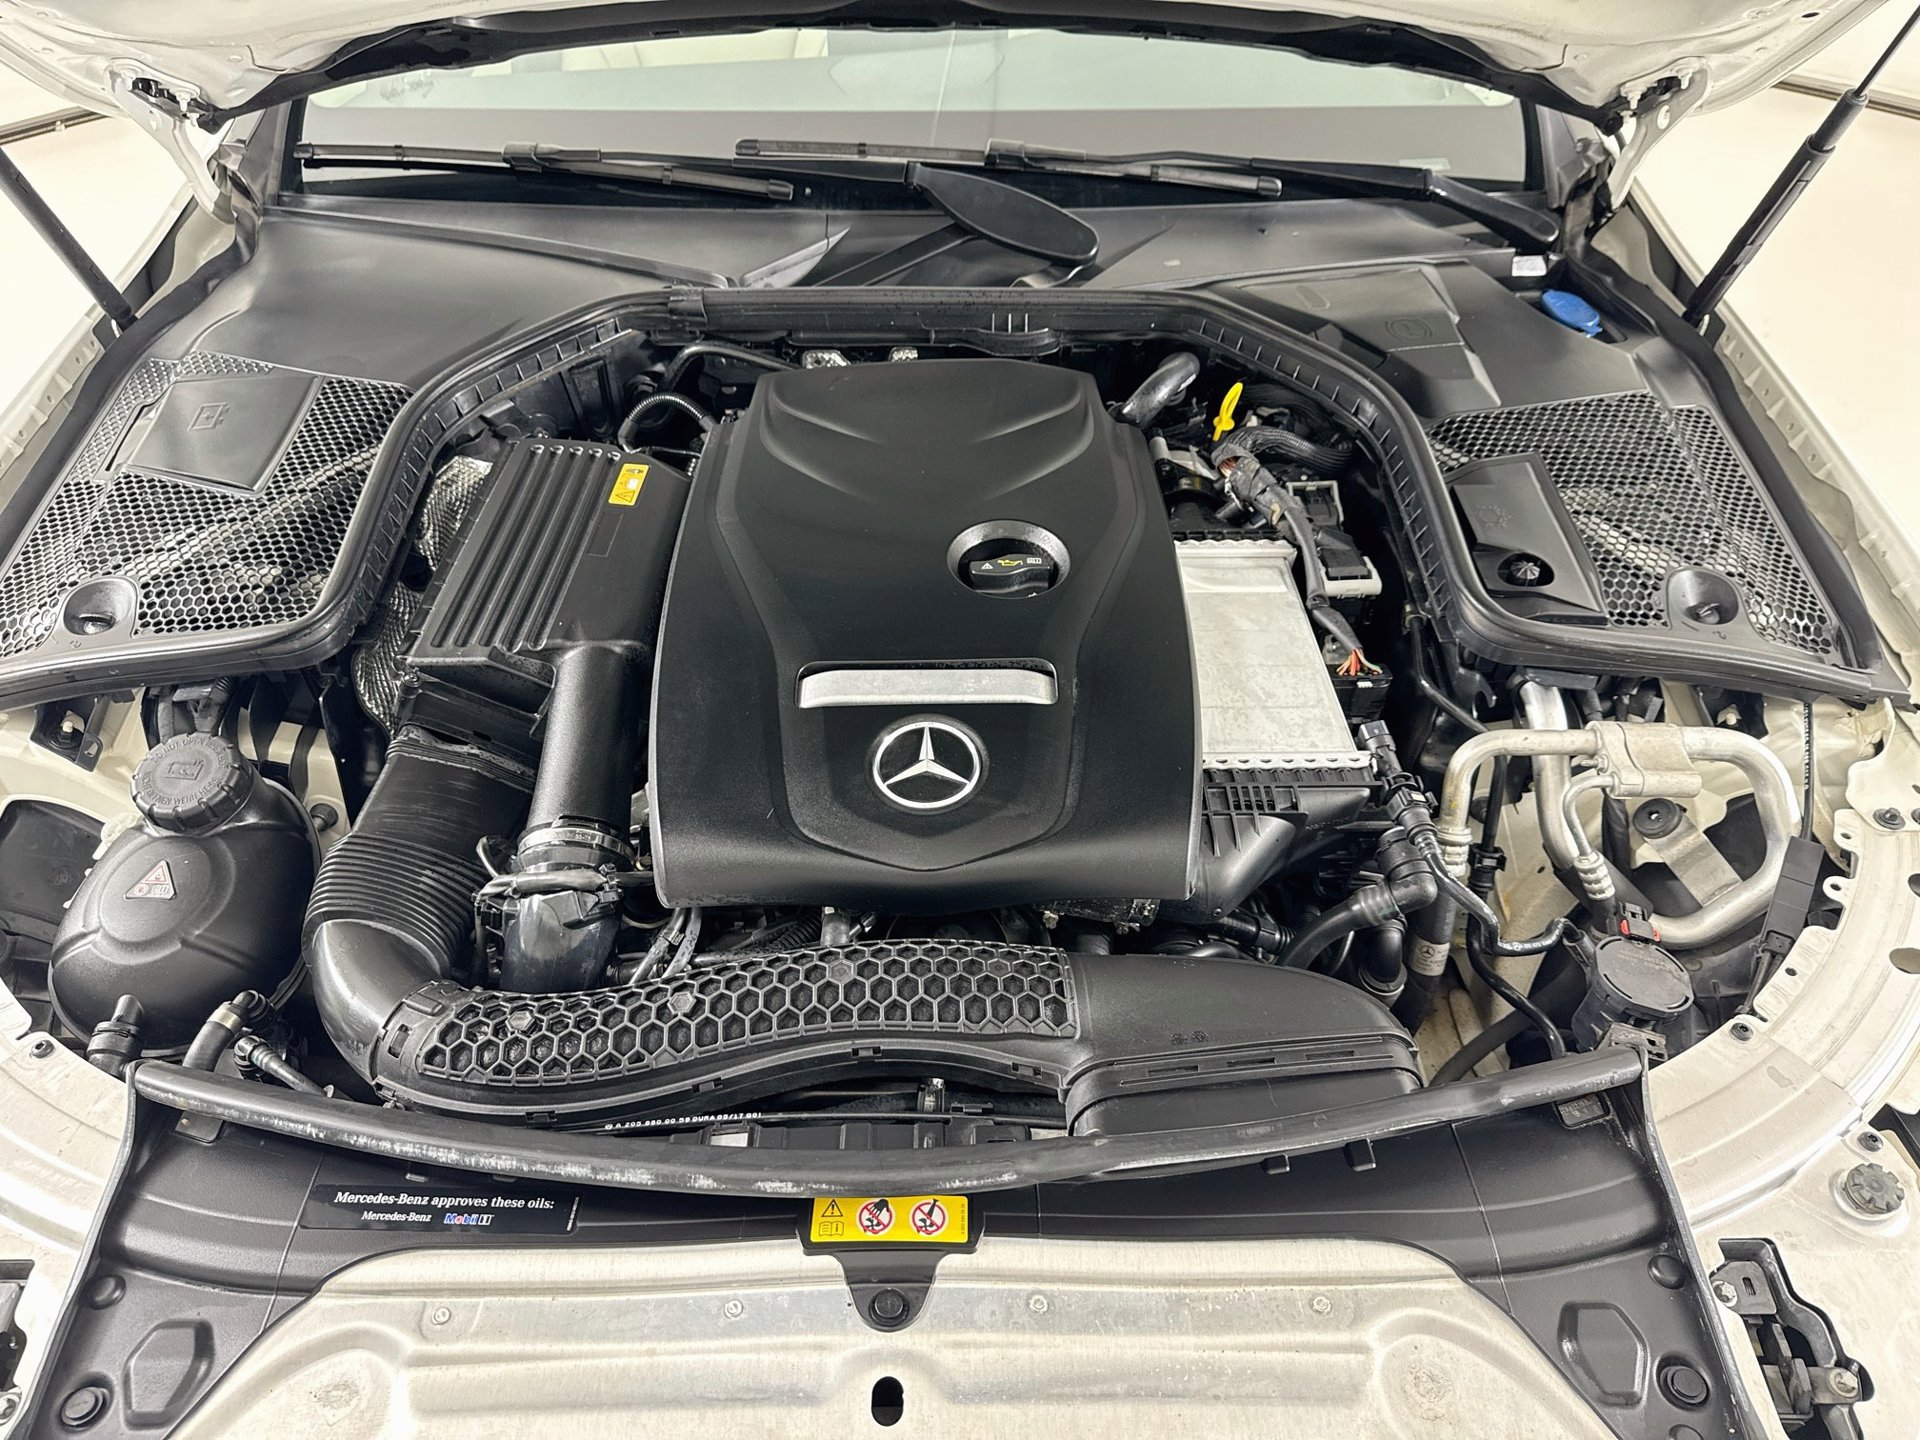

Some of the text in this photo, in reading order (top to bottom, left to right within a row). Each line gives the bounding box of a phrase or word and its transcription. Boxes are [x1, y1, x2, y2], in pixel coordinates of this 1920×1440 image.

[334, 1191, 555, 1209] Mercedes-Benz approves these oils:
[361, 1211, 432, 1222] Mercedes-Benz
[444, 1212, 479, 1225] Mobil
